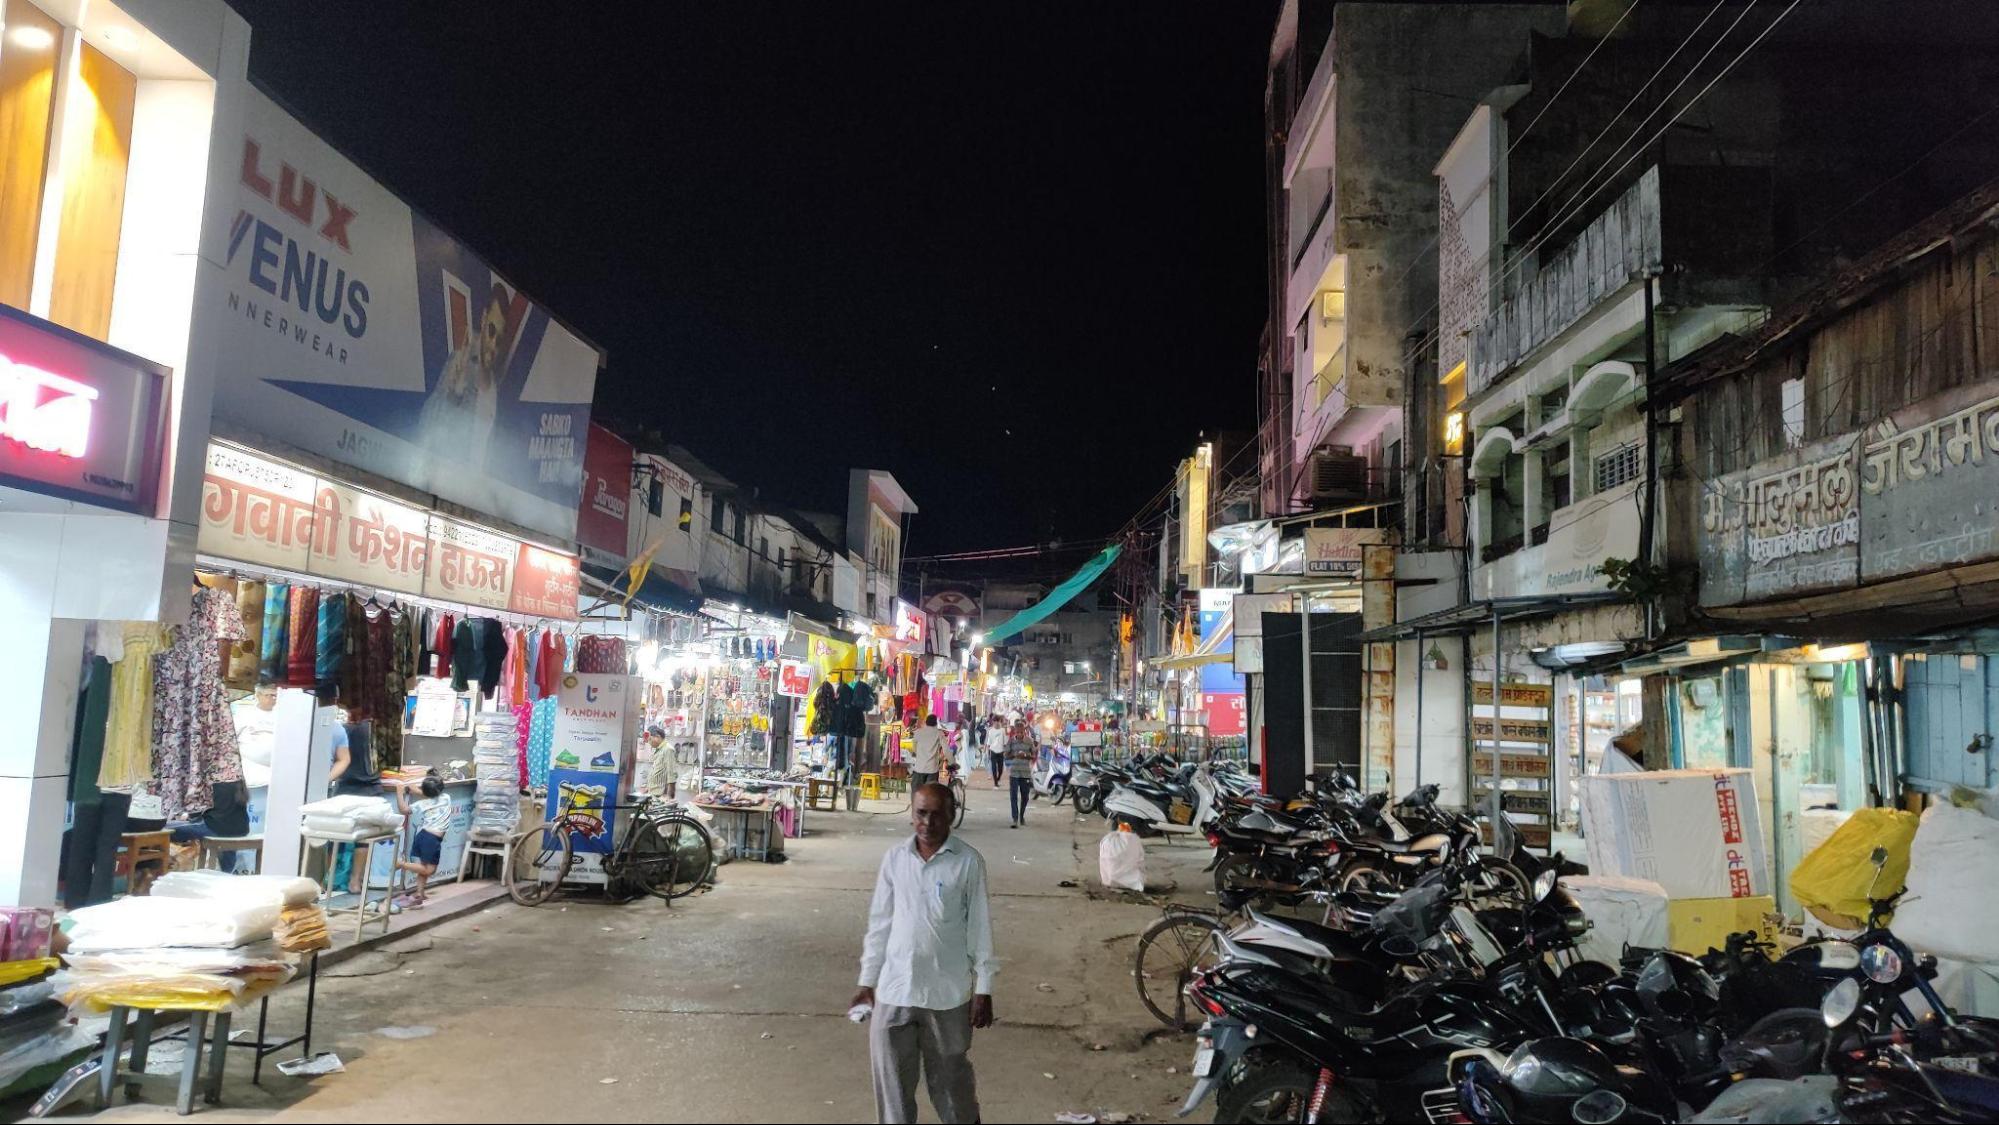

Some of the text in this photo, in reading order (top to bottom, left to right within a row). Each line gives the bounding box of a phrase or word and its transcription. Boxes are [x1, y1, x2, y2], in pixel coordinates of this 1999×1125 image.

[240, 132, 358, 254] LUX
[540, 412, 571, 436] SABKO
[349, 502, 437, 578] फैशन
[440, 541, 509, 593] हाऊस
[565, 707, 617, 719] TANDHAN
